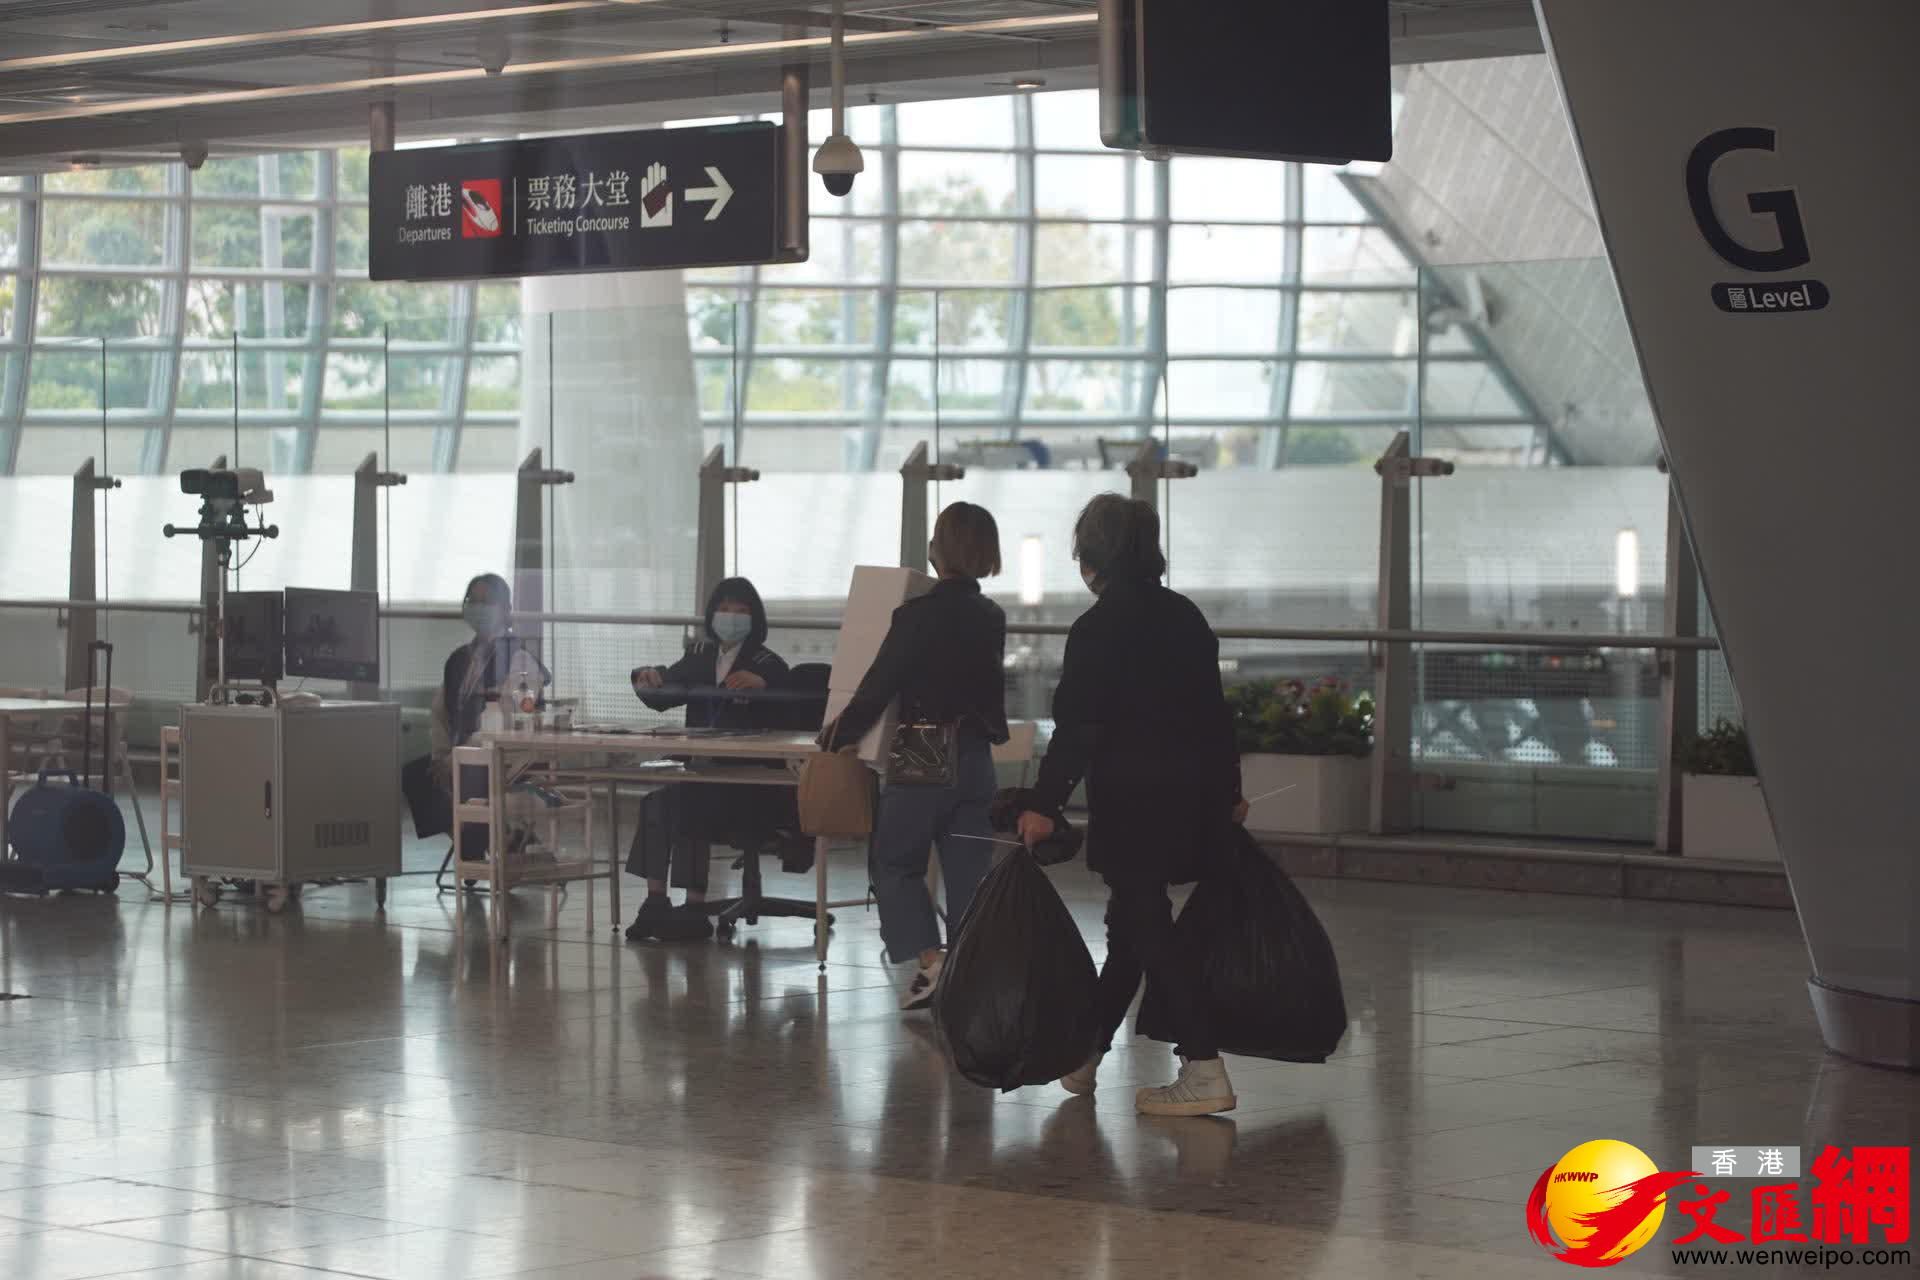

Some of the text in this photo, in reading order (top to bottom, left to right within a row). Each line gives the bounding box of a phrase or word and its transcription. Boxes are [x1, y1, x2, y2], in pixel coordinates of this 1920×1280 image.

[405, 182, 452, 220] 離港
[527, 170, 630, 211] 票務大堂
[1686, 127, 1810, 272] G
[399, 227, 452, 244] Departures
[527, 214, 630, 236] Ticketing Concourse
[1748, 284, 1812, 308] Level
